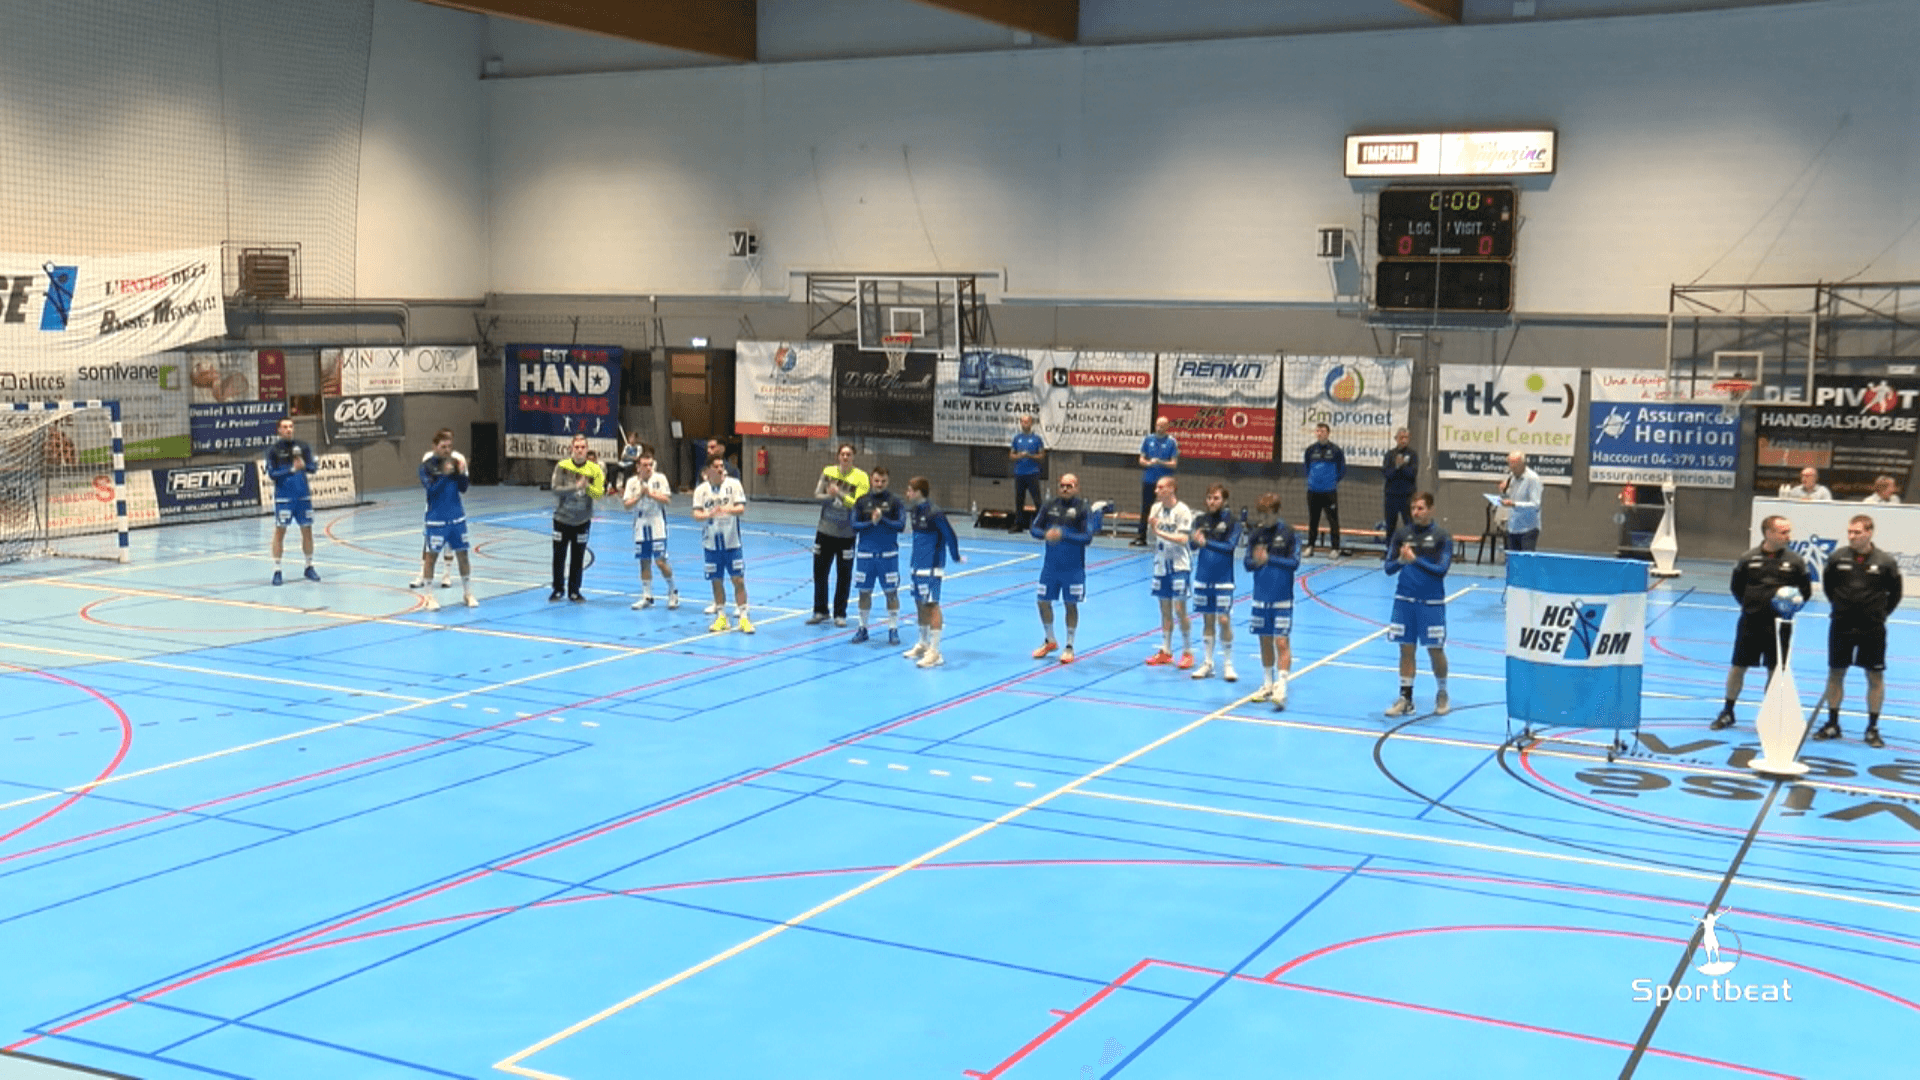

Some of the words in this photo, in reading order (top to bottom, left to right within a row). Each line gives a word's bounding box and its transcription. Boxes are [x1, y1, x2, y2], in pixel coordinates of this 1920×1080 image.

[543, 348, 568, 362] EST
[78, 361, 158, 381] somivane
[519, 363, 611, 394] HAND
[1074, 373, 1146, 385] TRAVHYDRO
[1180, 361, 1262, 379] RENKIN
[1443, 382, 1509, 416] rtk
[1764, 385, 1803, 402] DE
[943, 399, 972, 412] NEW
[974, 400, 1001, 413] KEV
[1004, 401, 1040, 414] CARS
[1058, 401, 1118, 412] LOCATION
[1637, 407, 1734, 425] Assurances
[1067, 412, 1125, 425] MONTAGE
[1301, 407, 1392, 426] j2mpronet
[1760, 411, 1918, 432] HANDBALSHOP.BE
[1443, 425, 1499, 443] Travel
[1506, 428, 1572, 445] Center
[1635, 425, 1734, 446] Henrion
[1592, 451, 1648, 465] Haccourt
[173, 469, 243, 490] RENKIN
[1540, 605, 1573, 628] HC
[1518, 627, 1567, 653] VISE
[1595, 632, 1632, 655] BM
